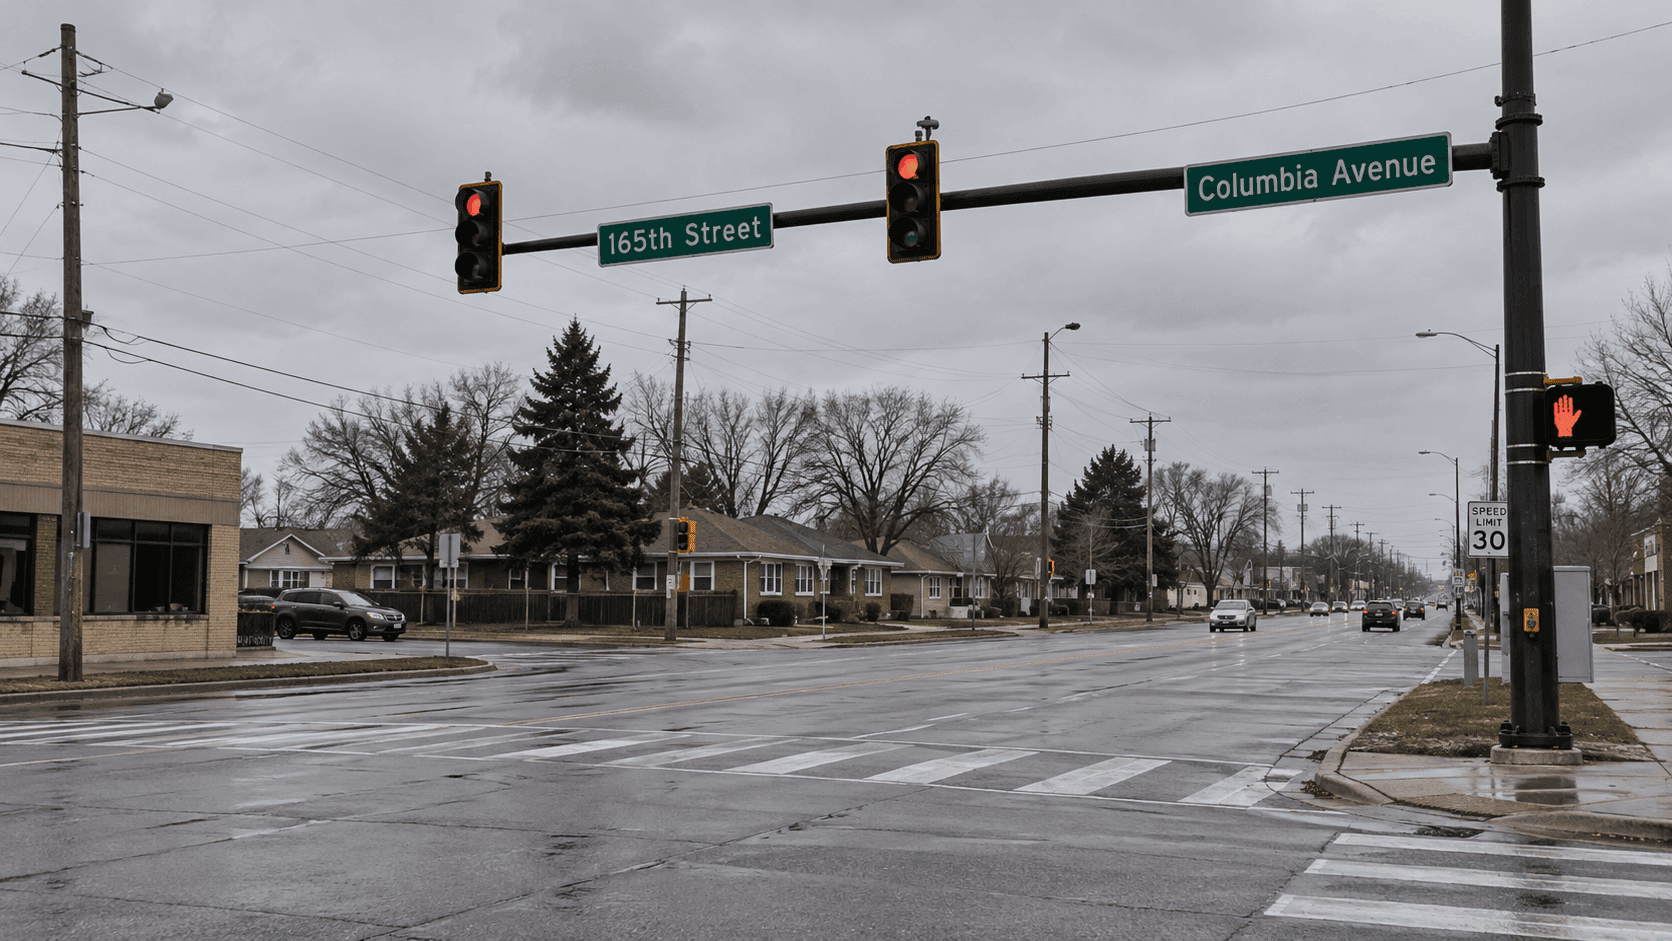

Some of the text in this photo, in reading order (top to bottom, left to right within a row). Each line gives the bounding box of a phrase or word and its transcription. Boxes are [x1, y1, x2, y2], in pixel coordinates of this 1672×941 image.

[1198, 154, 1437, 202] Columbia Avenue
[608, 215, 761, 255] 165th Street
[1472, 507, 1507, 516] SPEED
[1476, 519, 1503, 527] LIMIT
[1473, 530, 1505, 550] 30
